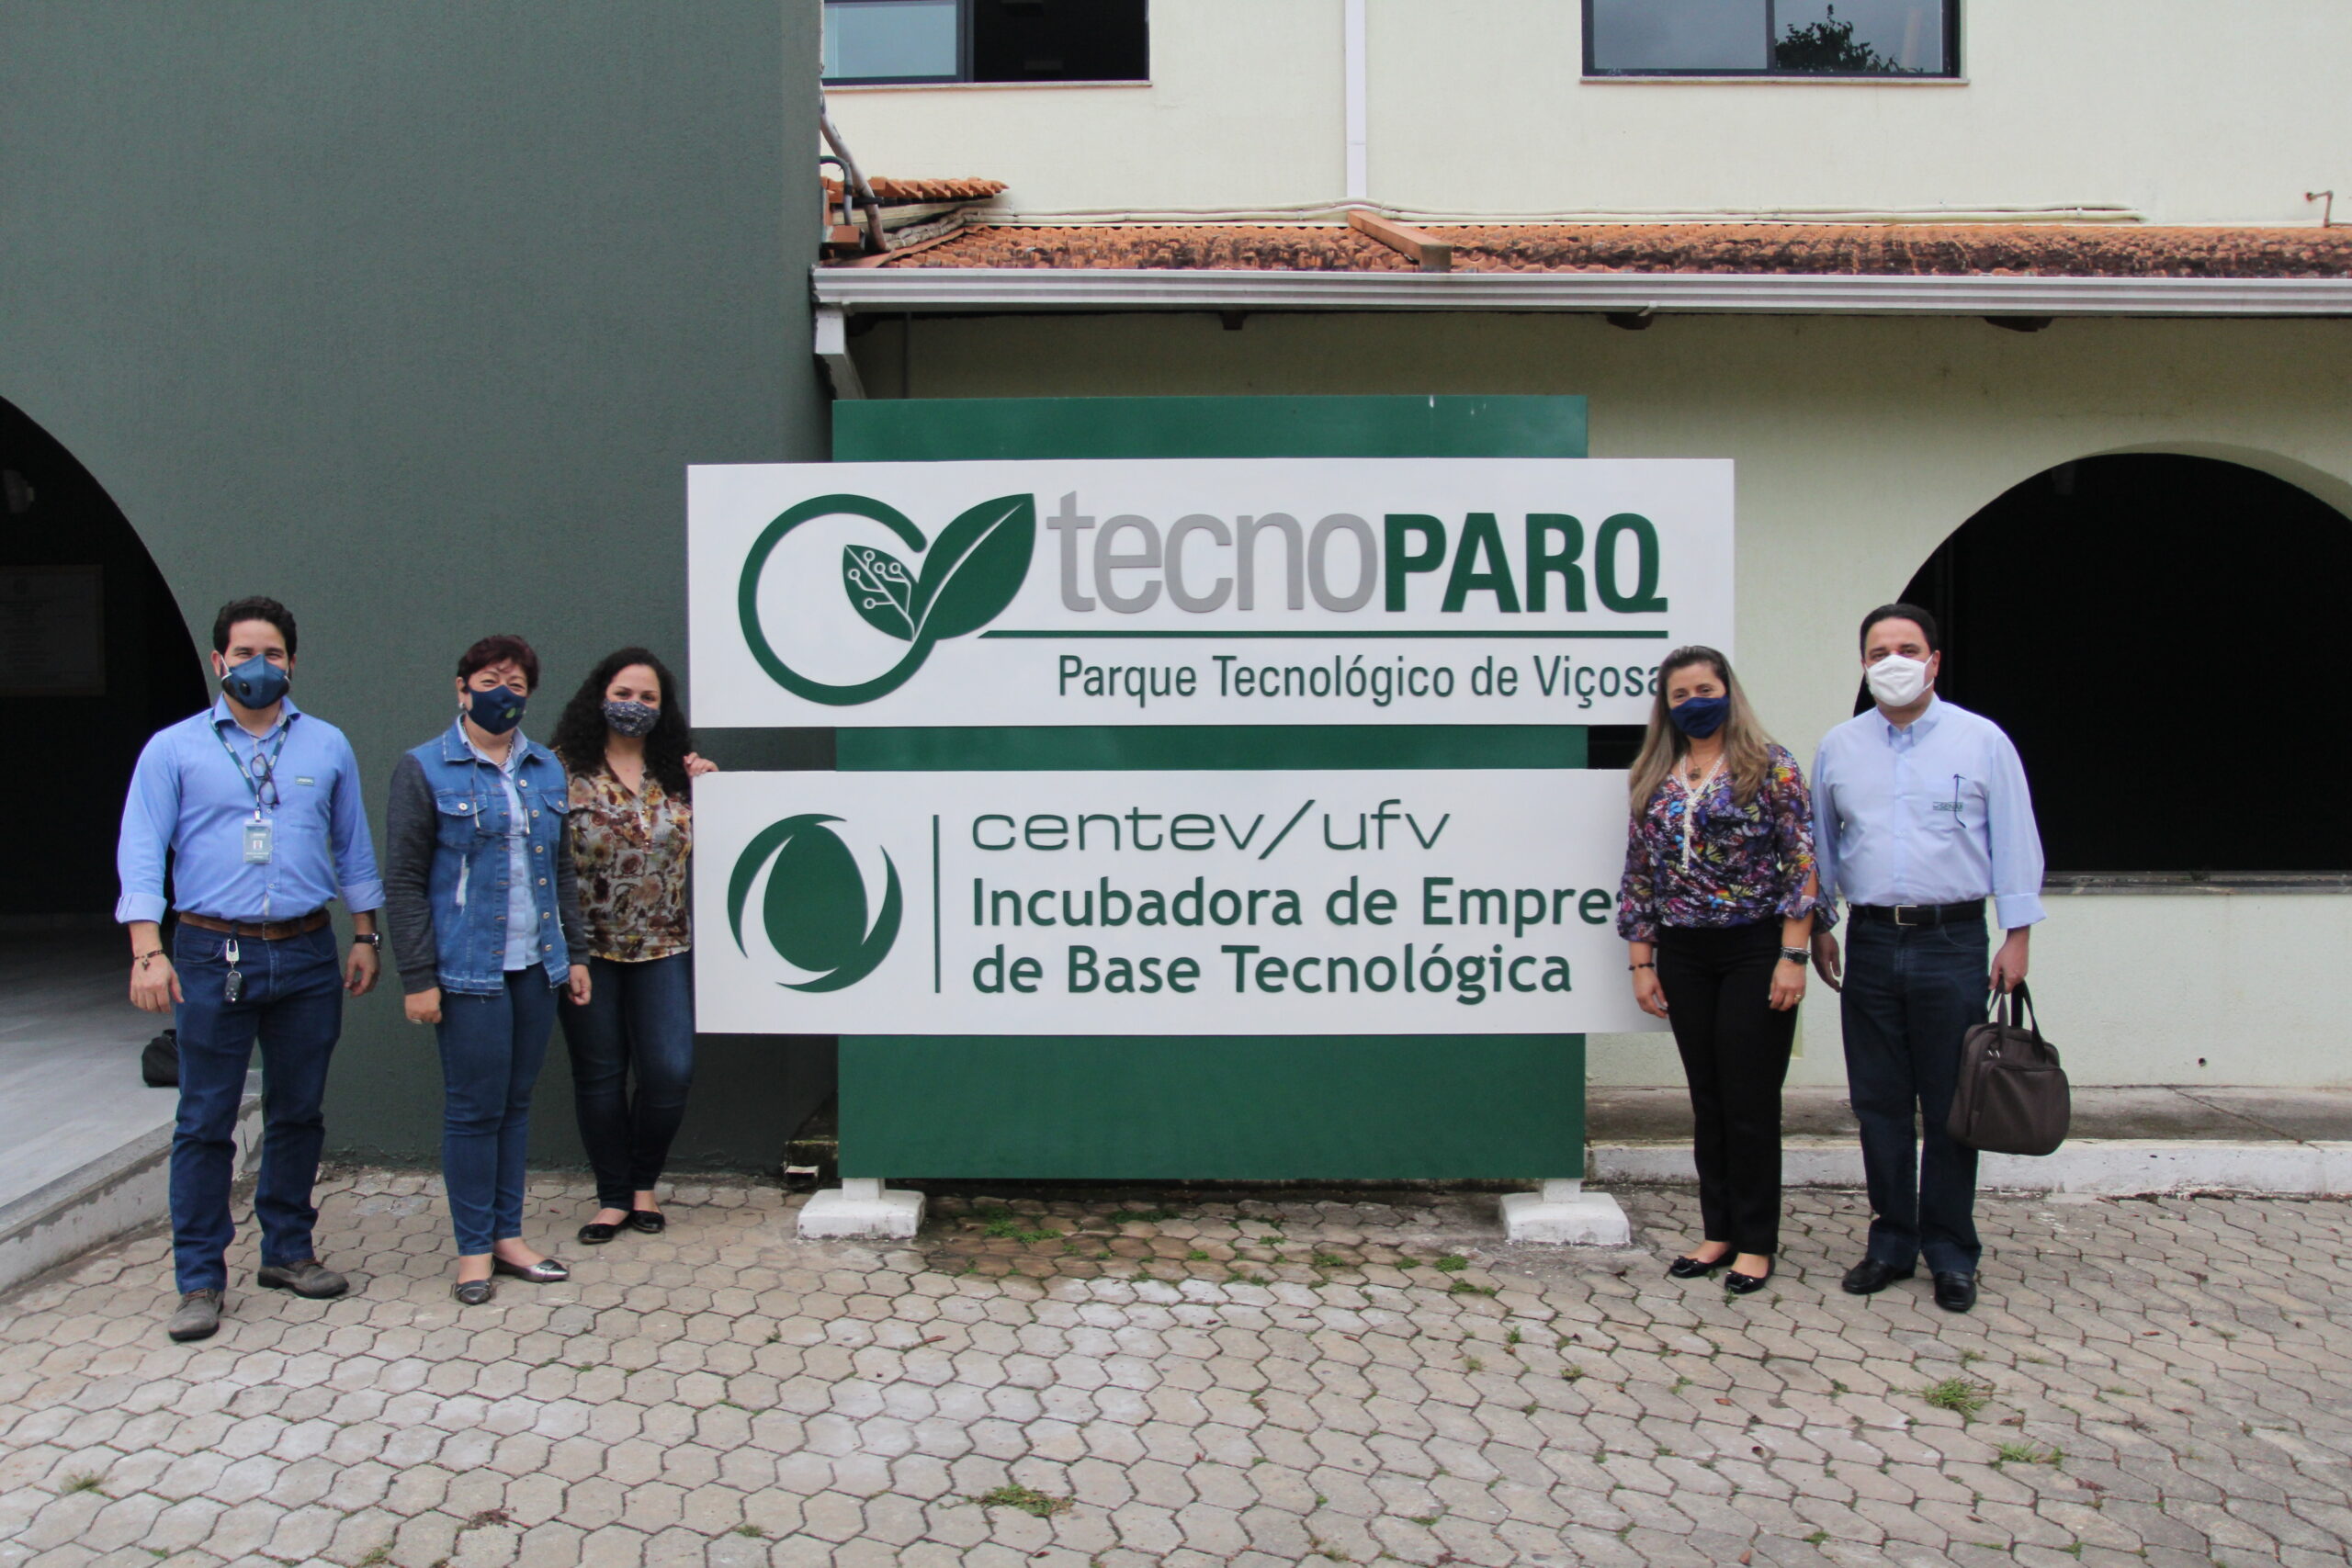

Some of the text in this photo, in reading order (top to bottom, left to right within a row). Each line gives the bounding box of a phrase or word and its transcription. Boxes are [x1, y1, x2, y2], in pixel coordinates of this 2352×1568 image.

[1046, 491, 1669, 615] tecnoPARQ
[1058, 654, 1197, 709] Parque
[1212, 653, 1454, 708] Tecnológico
[1471, 654, 1519, 697] de
[972, 798, 1451, 861] centev/ufv
[973, 874, 1623, 939] Incubadora de Empre
[972, 942, 1573, 1006] de Base Tecnológica
